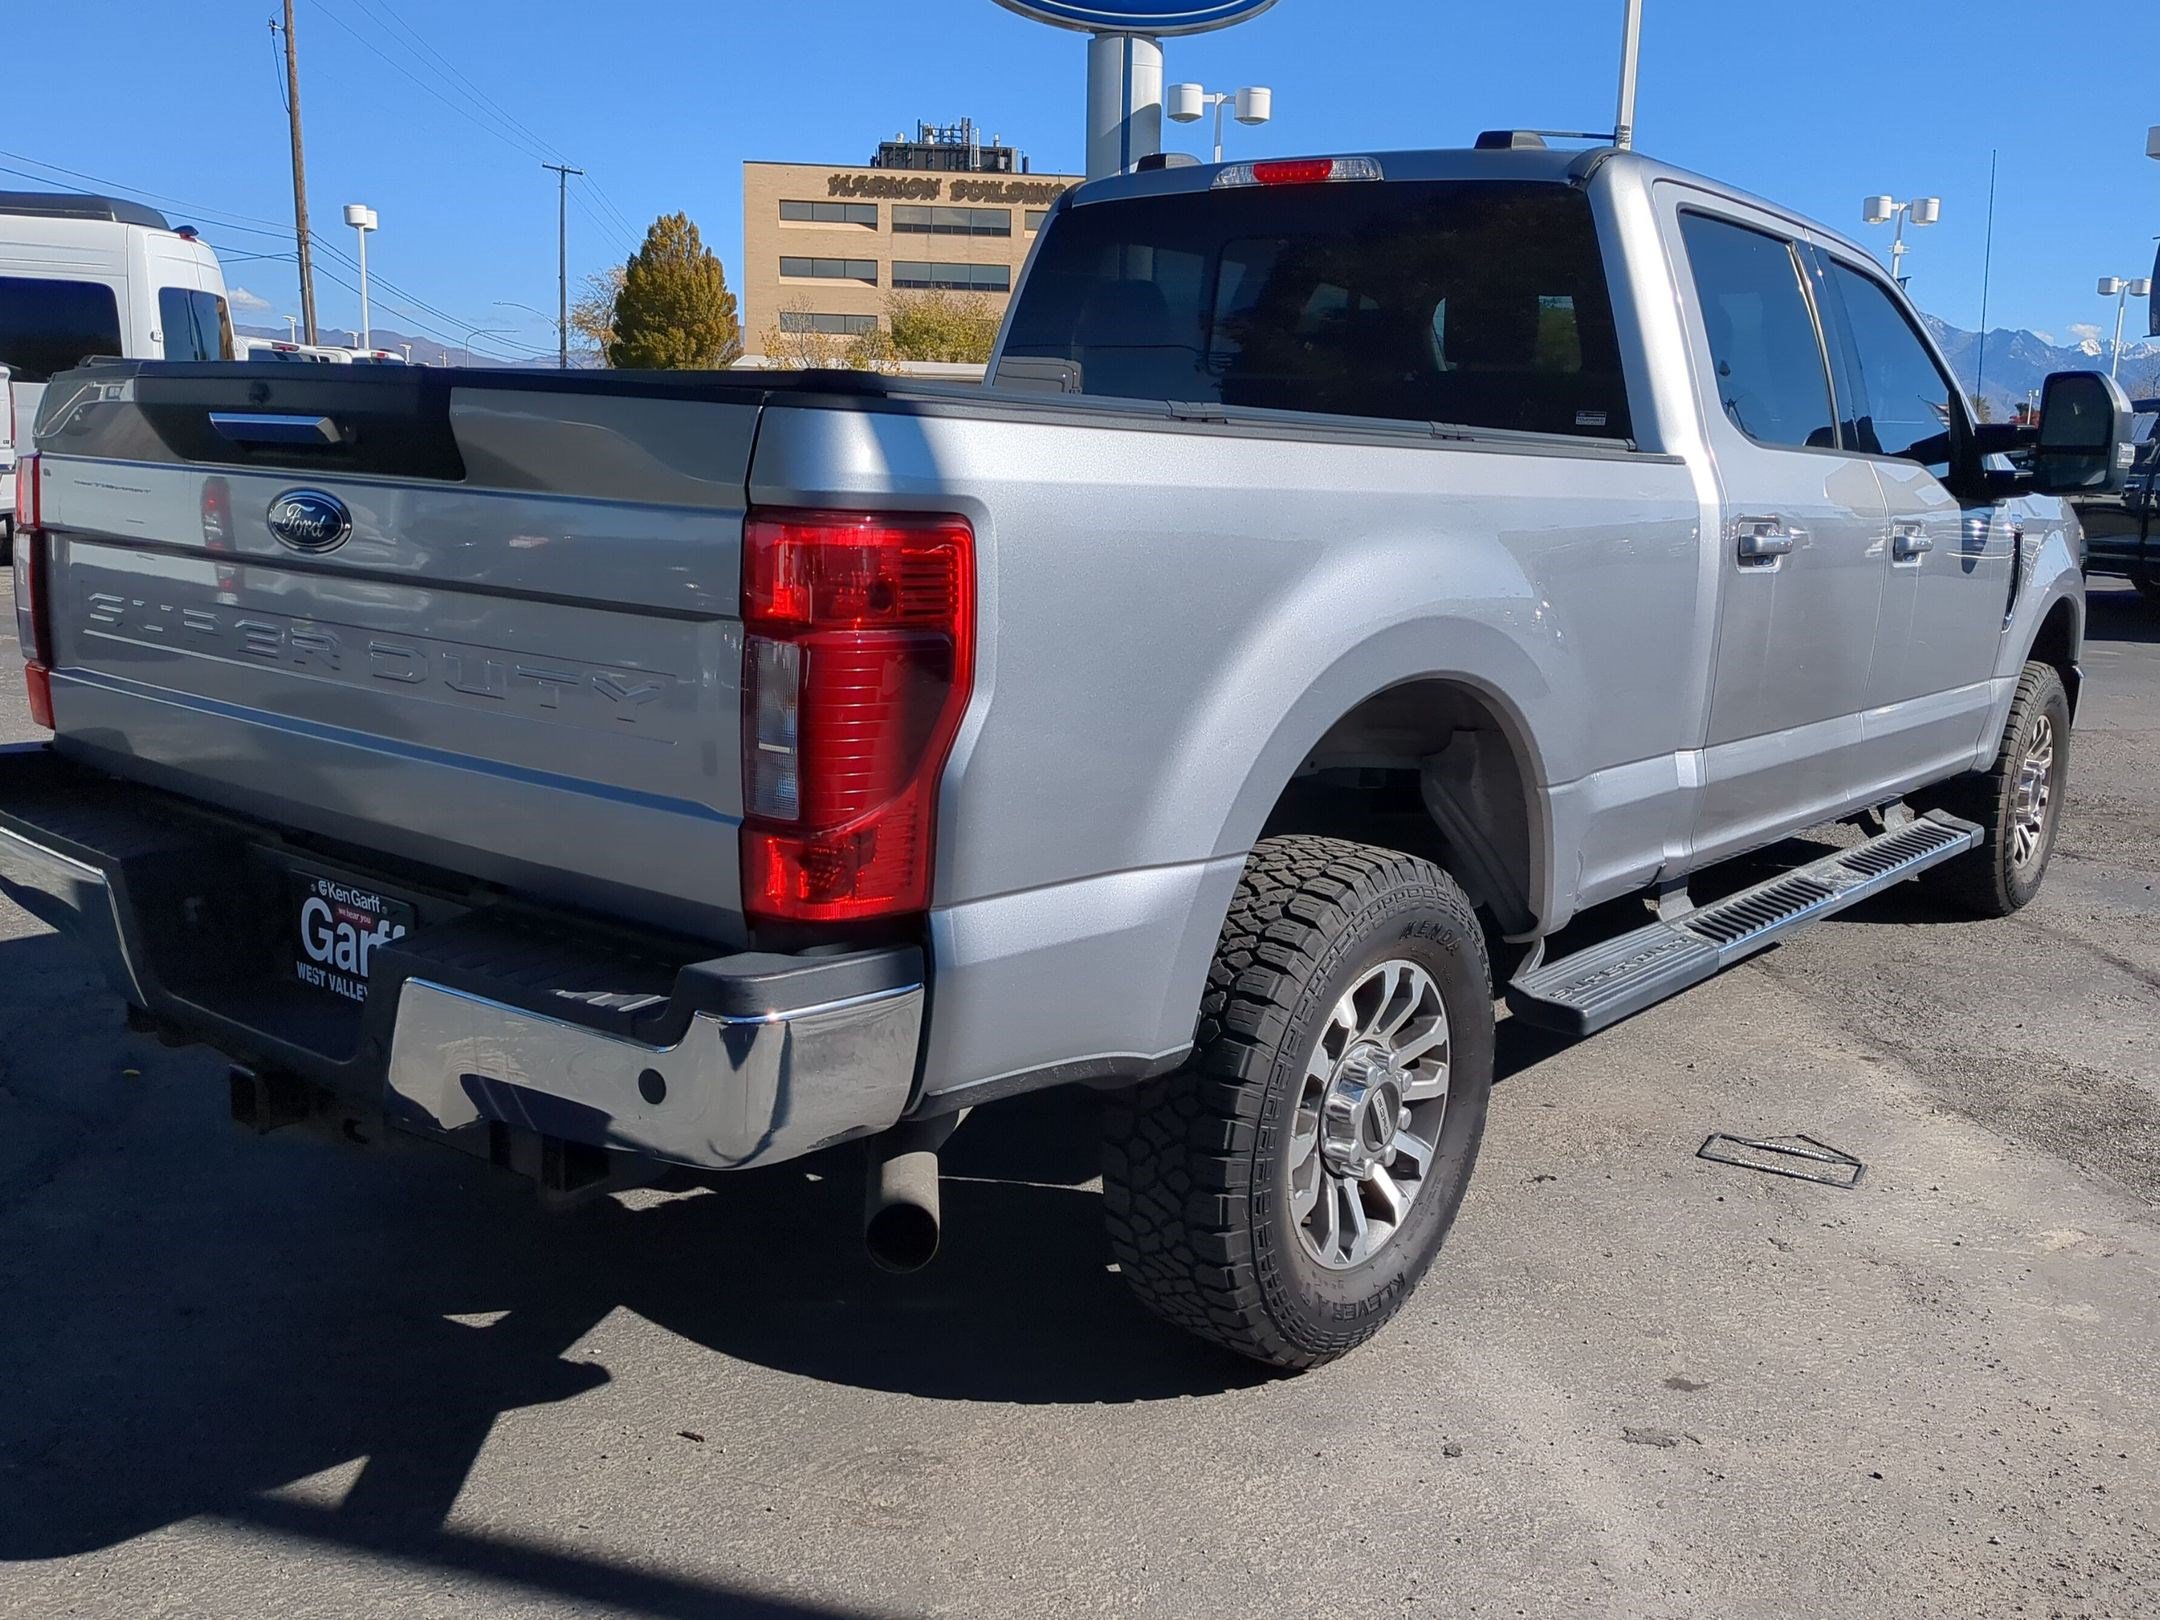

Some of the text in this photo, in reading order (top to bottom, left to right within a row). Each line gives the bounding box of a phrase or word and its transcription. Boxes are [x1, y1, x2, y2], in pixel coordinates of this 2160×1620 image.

[282, 503, 325, 537] Ford
[87, 592, 664, 723] SUPER DUTY
[327, 882, 381, 913] Ken Garff
[346, 907, 360, 921] hear
[360, 914, 371, 924] you
[301, 896, 405, 977] Gar
[1399, 920, 1461, 957] KENDA
[297, 960, 326, 988] WEST
[1549, 961, 1638, 1000] SUPER
[1738, 1159, 1819, 1180] Chevrolet Murray
[1800, 1149, 1829, 1159] Miller
[1331, 1271, 1406, 1321] KLEVER
